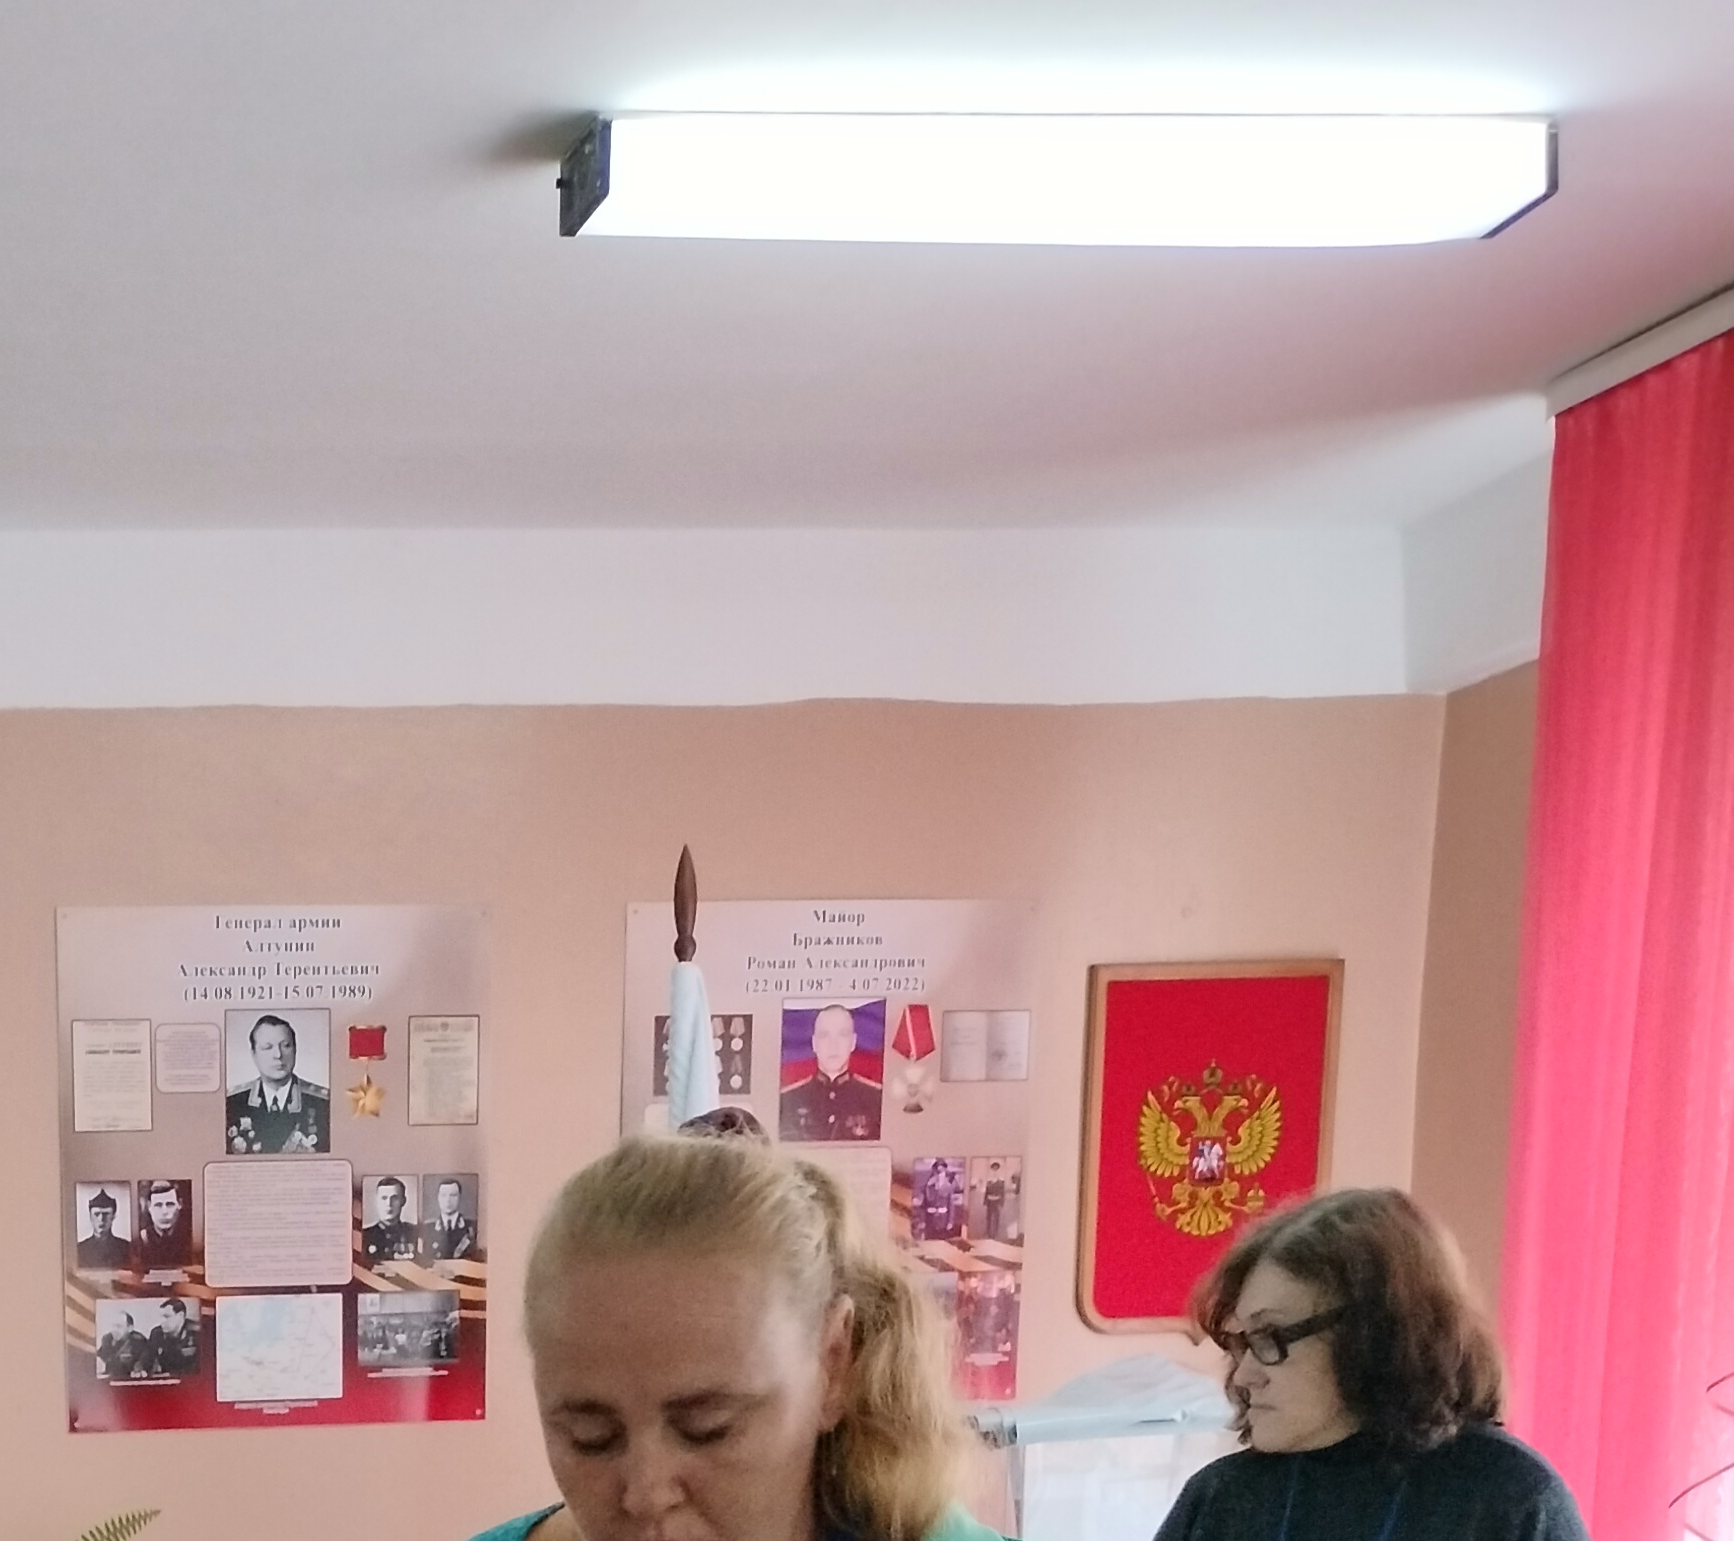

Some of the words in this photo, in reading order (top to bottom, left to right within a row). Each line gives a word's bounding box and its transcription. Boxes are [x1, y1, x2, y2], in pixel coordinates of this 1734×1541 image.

[215, 915, 282, 933] Генерал
[288, 917, 341, 933] армии
[243, 939, 315, 956] Алтунин
[792, 932, 883, 950] Бражников
[178, 962, 267, 980] Александр
[275, 962, 380, 979] Терентьевич
[747, 956, 797, 970] Роман
[805, 956, 926, 972] Александрович
